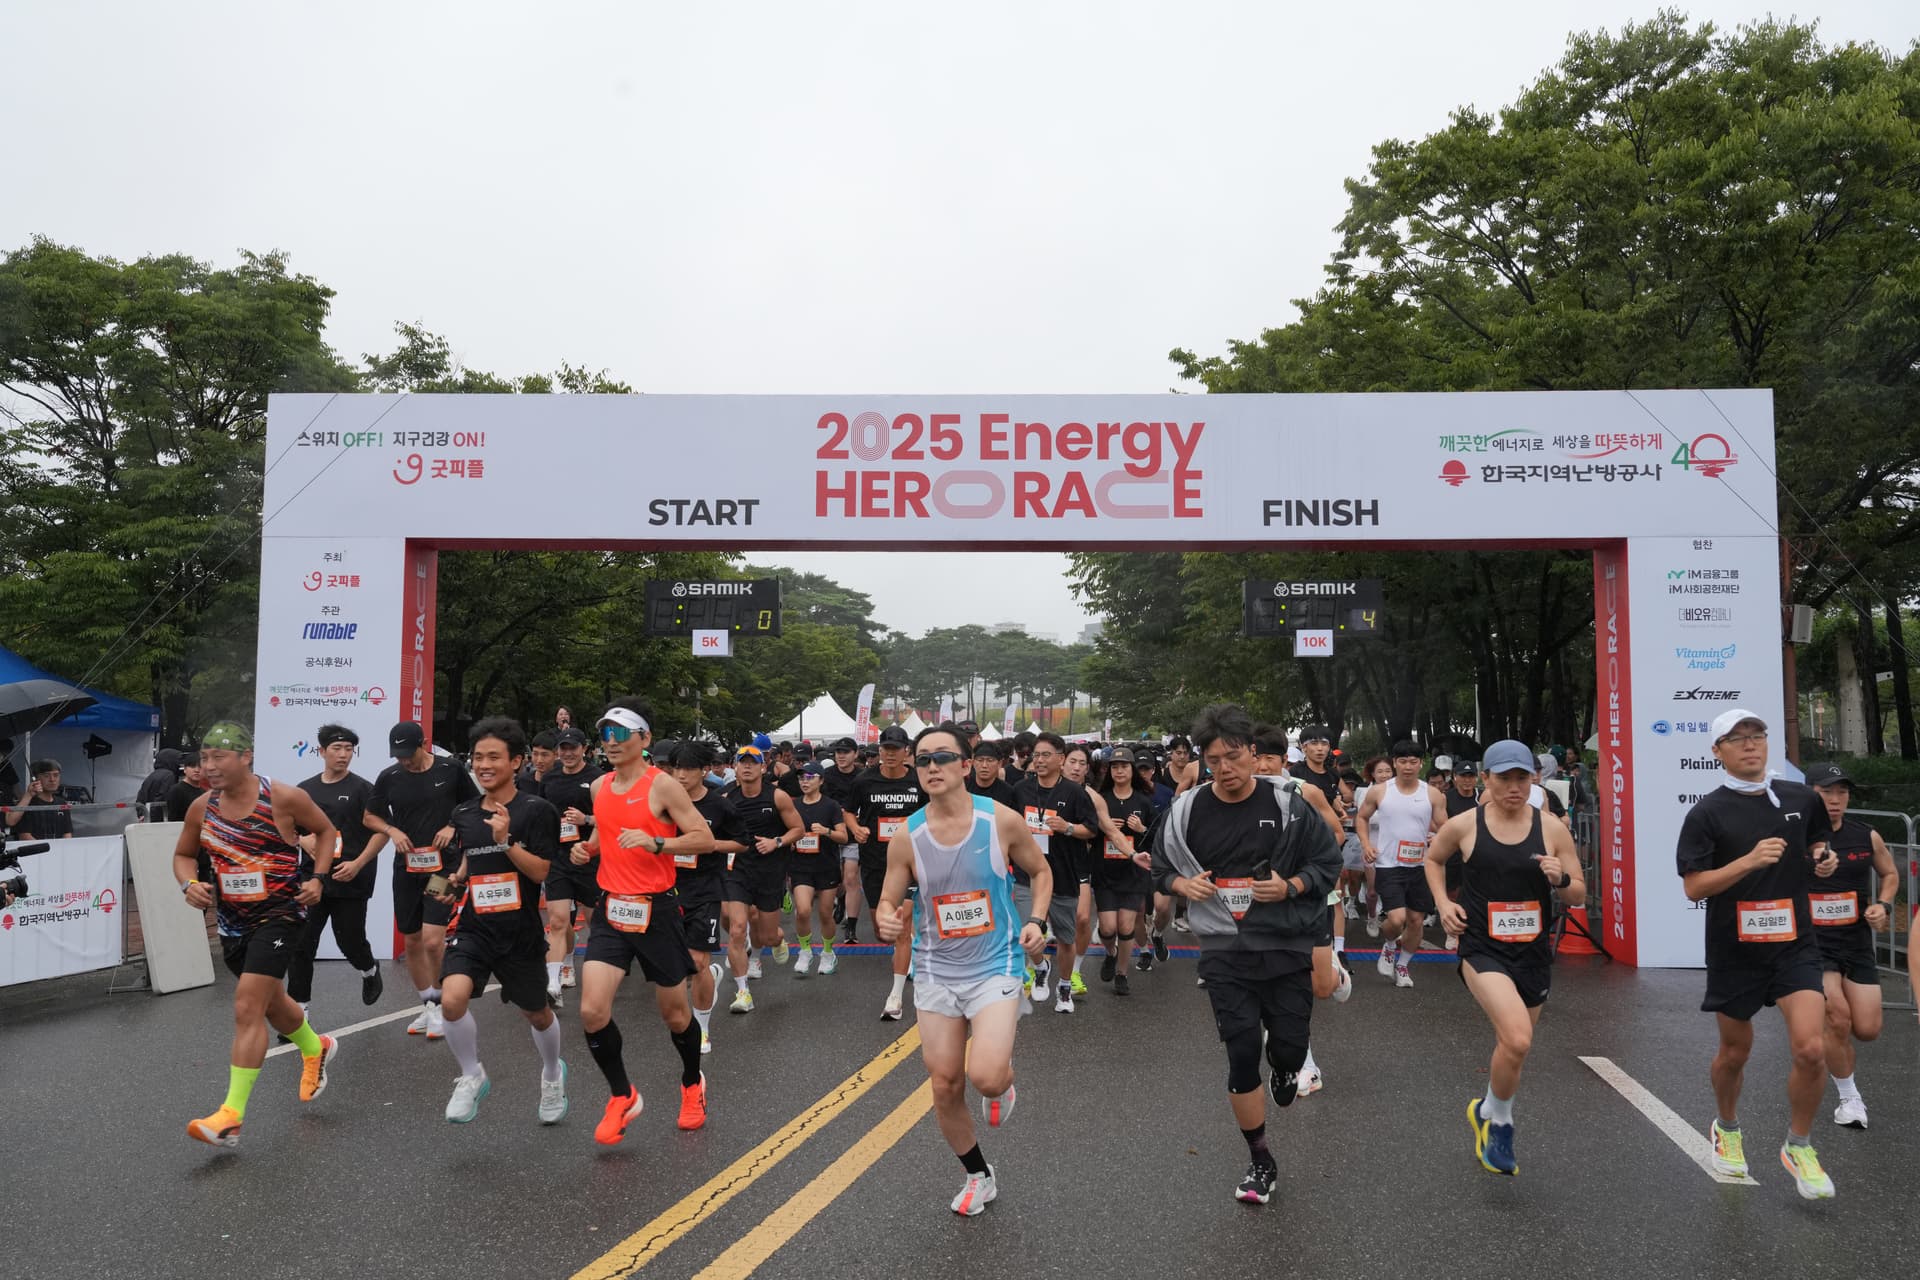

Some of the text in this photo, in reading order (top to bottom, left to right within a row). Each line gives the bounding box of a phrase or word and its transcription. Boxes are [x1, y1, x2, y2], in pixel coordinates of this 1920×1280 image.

[297, 431, 486, 447] 스위치 OFF! 지구건강 ON!
[816, 411, 1206, 478] 2025 Energy
[1439, 432, 1663, 452] 깨끗한 에너지로 세상을 따뜻하게
[431, 459, 485, 479] 굿피플
[1480, 463, 1663, 483] 한국지역난방공사
[815, 470, 1204, 519] HERO RACE
[648, 498, 760, 526] START
[1263, 499, 1379, 526] FINISH
[323, 552, 343, 563] 주최
[327, 574, 361, 588] 굿피플
[688, 583, 753, 595] SAMIK
[1290, 582, 1357, 595] SAMIK
[321, 606, 341, 616] 주관
[415, 562, 427, 651] RACE
[302, 622, 358, 640] runable
[701, 636, 719, 647] 5K
[1302, 636, 1328, 648] 10K
[1675, 647, 1720, 658] Vitamin
[305, 656, 353, 668] 공식후원사
[1687, 659, 1726, 671] Angels
[1672, 685, 1741, 700] EXTREME
[1605, 563, 1625, 940] 2025 Energy HERO RACE
[870, 794, 919, 803] UNKNOWN
[478, 891, 485, 900] A
[1222, 895, 1230, 905] A
[611, 906, 618, 915] A
[1817, 906, 1825, 914] A
[945, 912, 954, 922] A
[1497, 918, 1507, 928] A
[1747, 918, 1757, 927] A
[710, 919, 718, 937] 7
